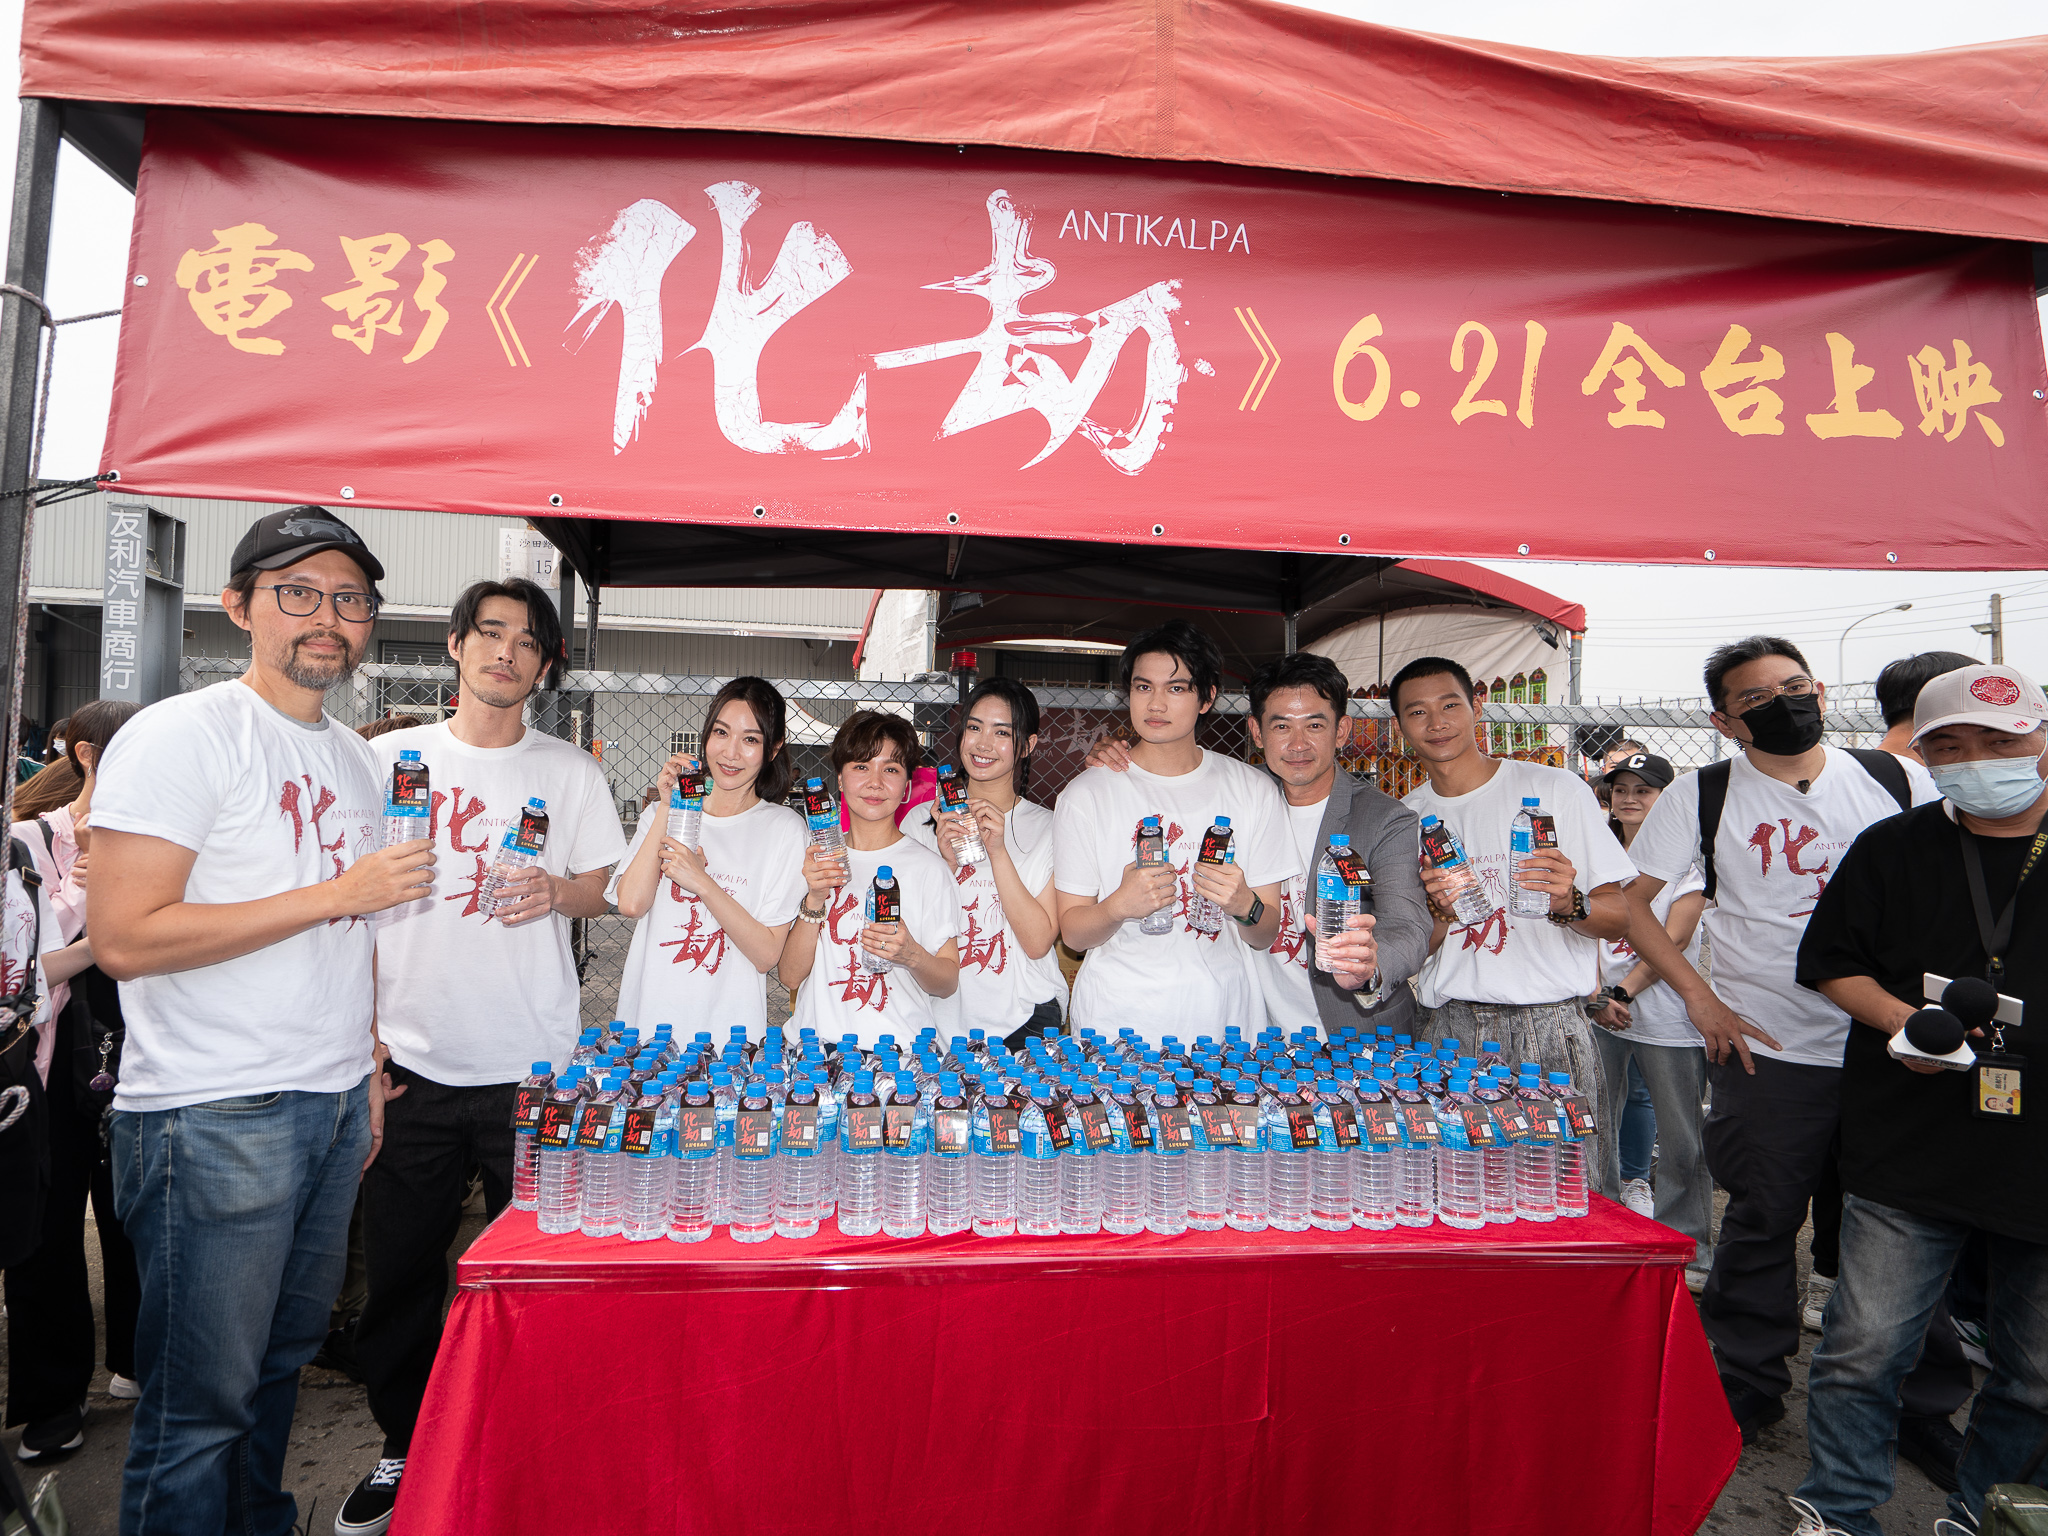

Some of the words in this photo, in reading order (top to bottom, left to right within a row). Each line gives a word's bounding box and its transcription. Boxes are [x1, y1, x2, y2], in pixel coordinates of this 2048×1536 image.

[1059, 209, 1251, 256] ANTIKALPA
[174, 221, 456, 365] 電影
[1332, 312, 1548, 429] 6.21
[1581, 320, 2004, 448] 全台上映
[536, 560, 552, 574] 15
[102, 509, 144, 691] 友利汽車商行
[1628, 754, 1647, 769] C
